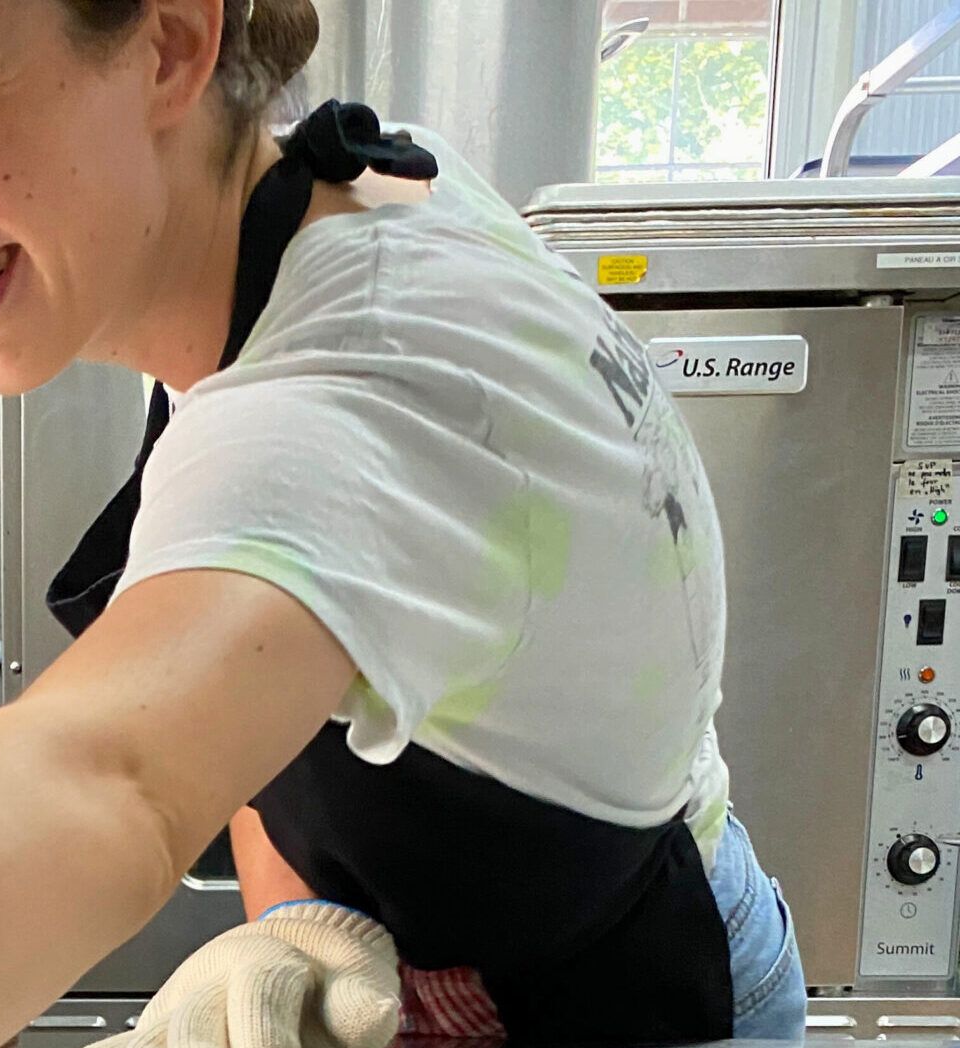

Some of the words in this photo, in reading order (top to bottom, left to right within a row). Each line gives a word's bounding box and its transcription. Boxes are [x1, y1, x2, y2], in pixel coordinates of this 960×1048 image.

[682, 358, 721, 377] U.S.
[725, 358, 796, 381] Range
[928, 498, 952, 506] POWER
[877, 942, 935, 955] Summit
